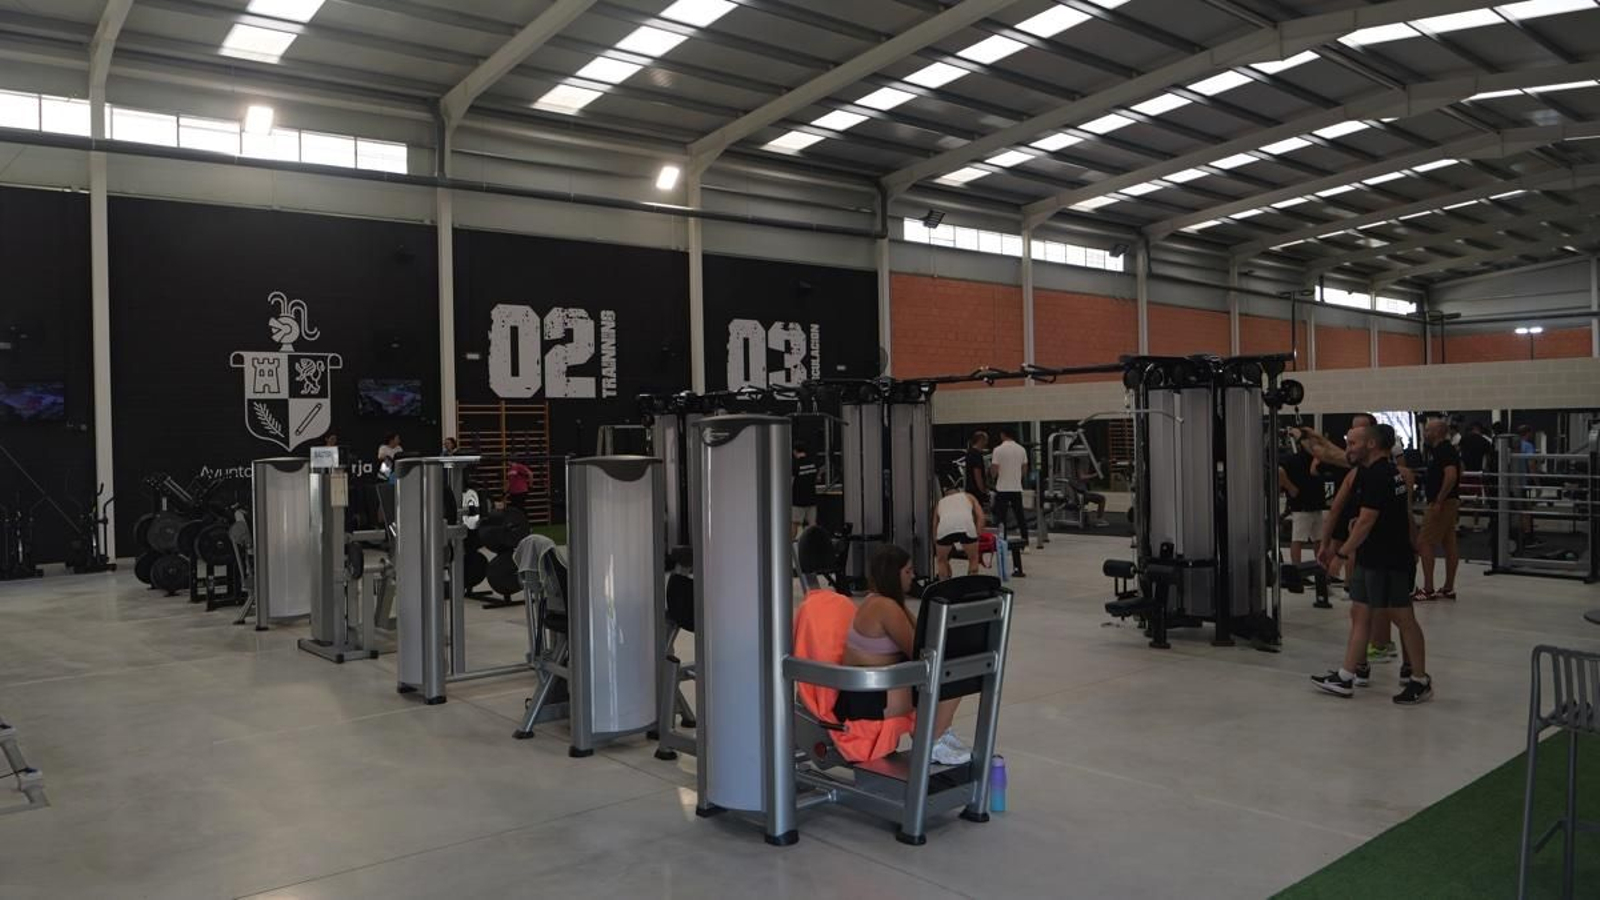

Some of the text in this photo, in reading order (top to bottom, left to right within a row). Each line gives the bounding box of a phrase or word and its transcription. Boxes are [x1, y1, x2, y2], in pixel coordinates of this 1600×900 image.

[488, 303, 597, 398] 02
[726, 318, 807, 400] 03
[351, 459, 373, 477] rja
